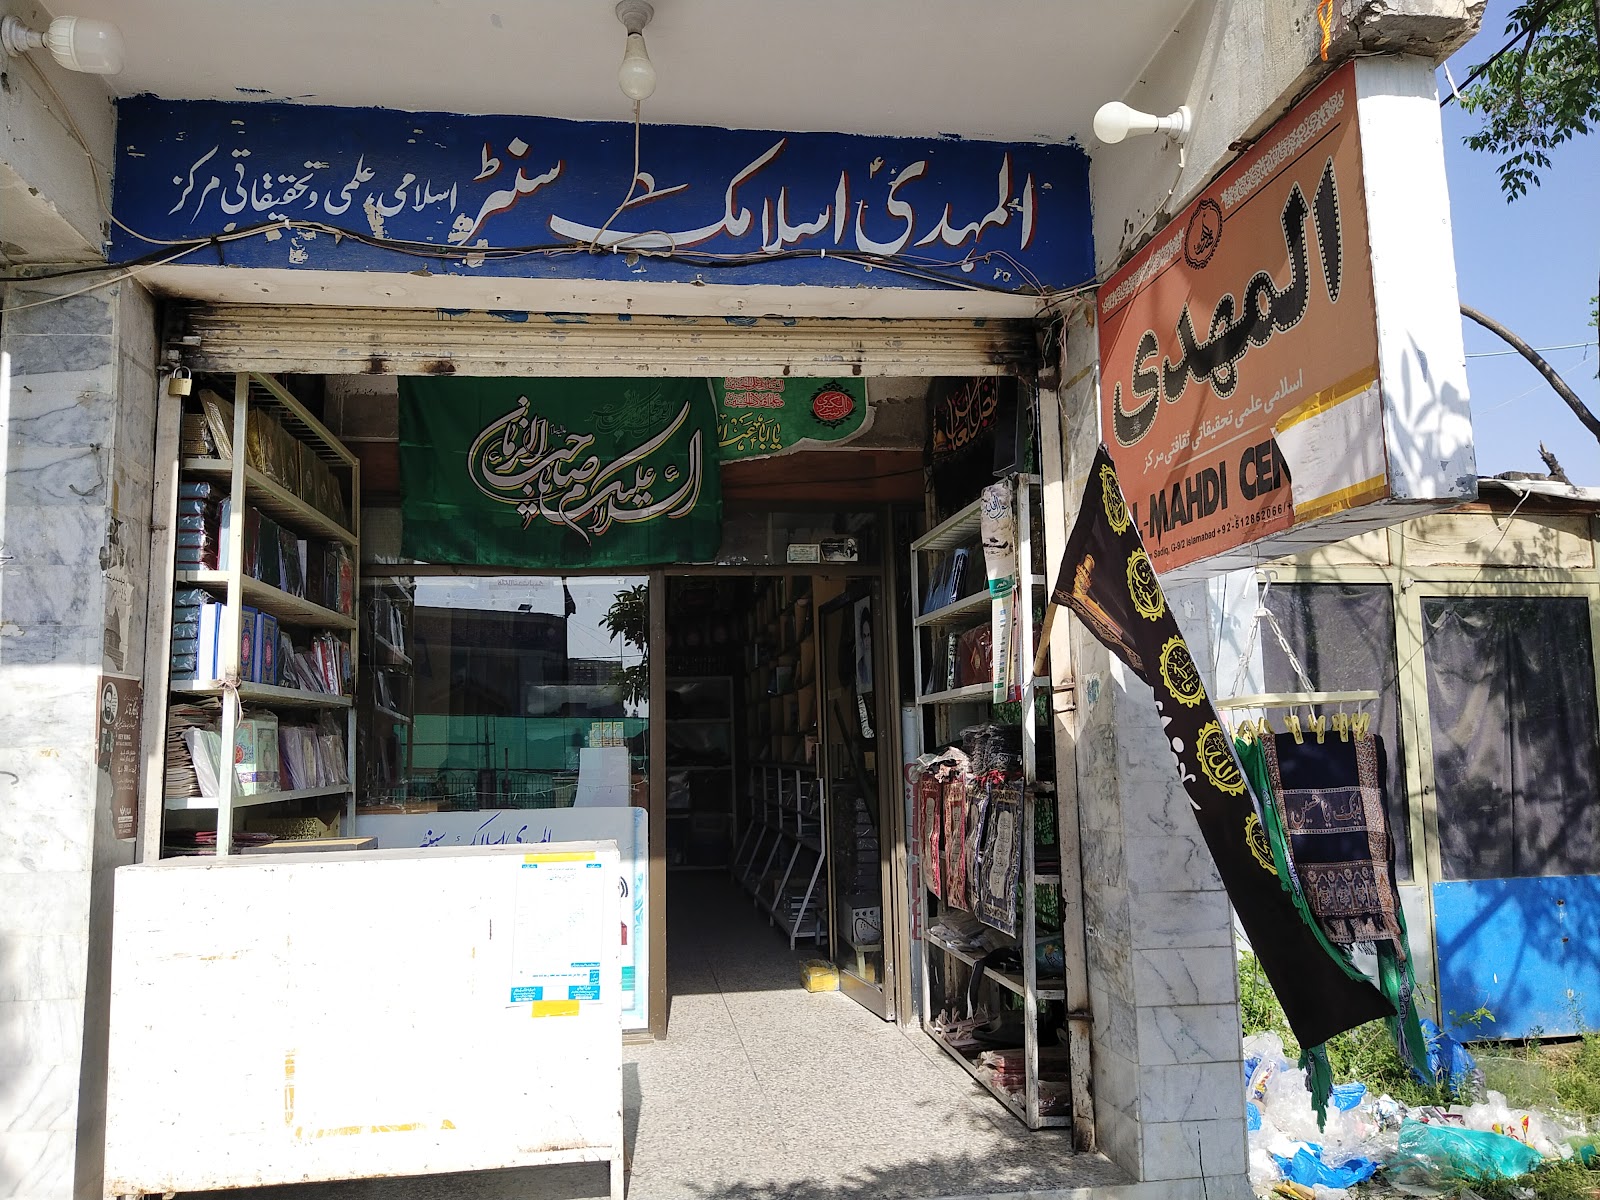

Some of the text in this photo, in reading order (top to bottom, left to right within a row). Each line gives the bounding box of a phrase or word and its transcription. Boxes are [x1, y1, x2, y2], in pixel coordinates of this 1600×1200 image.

[168, 144, 219, 225] مرکز
[324, 153, 376, 216] علمی
[1234, 394, 1263, 429] علمی
[1263, 368, 1304, 414] اسلامی
[1191, 409, 1234, 451] تحقیقاتی
[1142, 448, 1165, 475] مرکز
[1132, 459, 1229, 547] L-MAHDI
[1239, 437, 1293, 501] CEN
[1186, 527, 1216, 547] Islamabad
